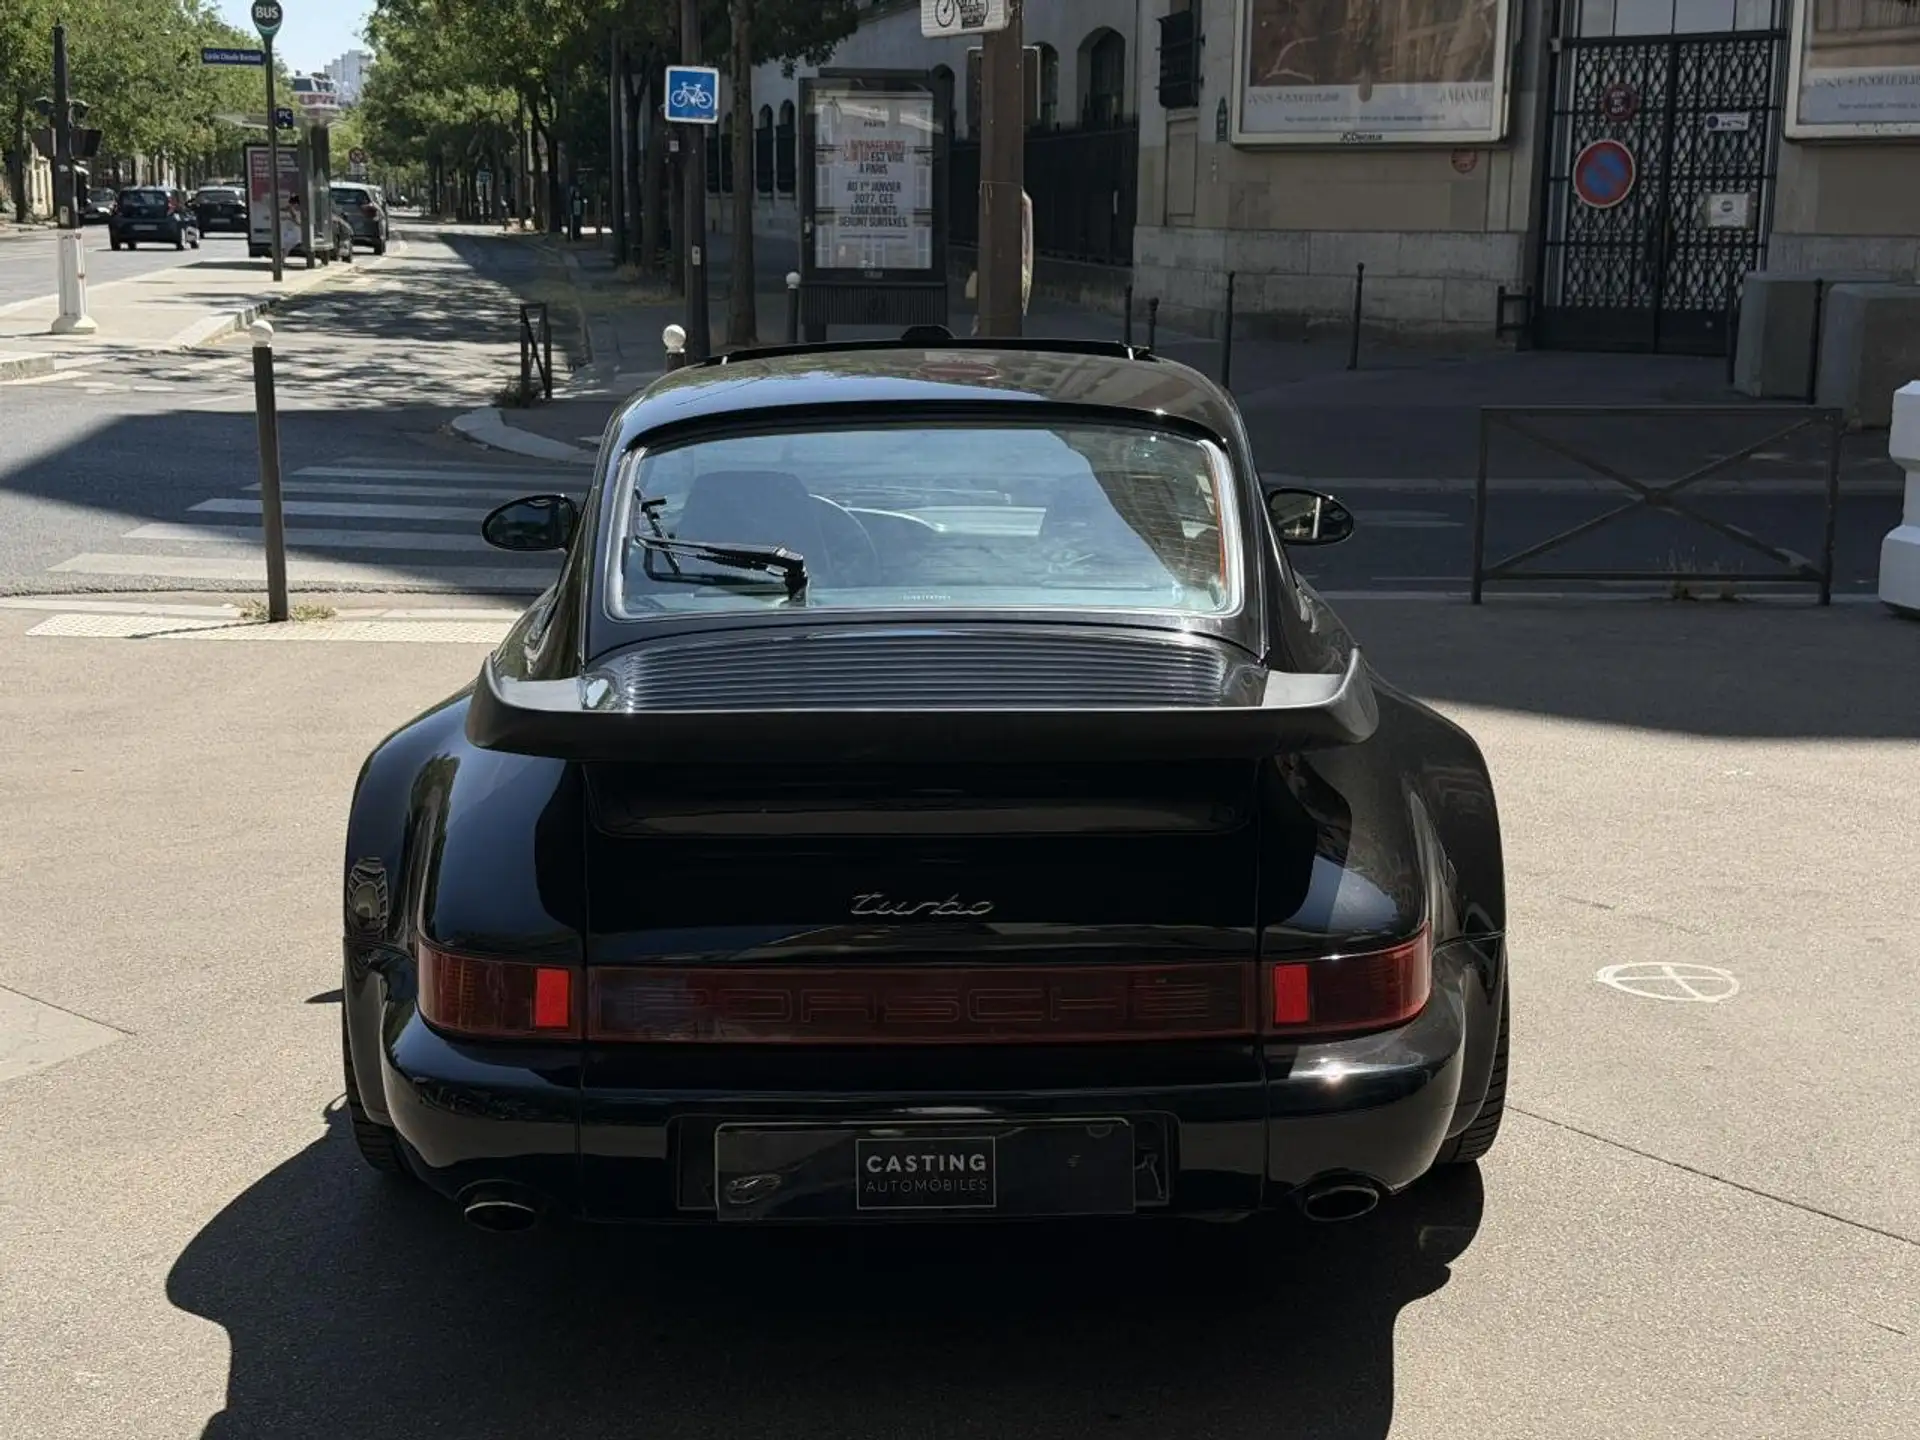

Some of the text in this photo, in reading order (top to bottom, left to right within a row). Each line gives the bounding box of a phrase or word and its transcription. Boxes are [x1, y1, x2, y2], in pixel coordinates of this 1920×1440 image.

[255, 6, 279, 19] BUS
[278, 110, 291, 120] PC
[847, 181, 857, 191] AU
[871, 181, 902, 192] JANVIER
[850, 204, 898, 215] LOGEMENTS
[838, 216, 867, 227] SERONT
[633, 979, 1209, 1023] PORSCHE
[866, 1152, 988, 1174] CASTING
[865, 1178, 989, 1195] AUTOMOBILES
